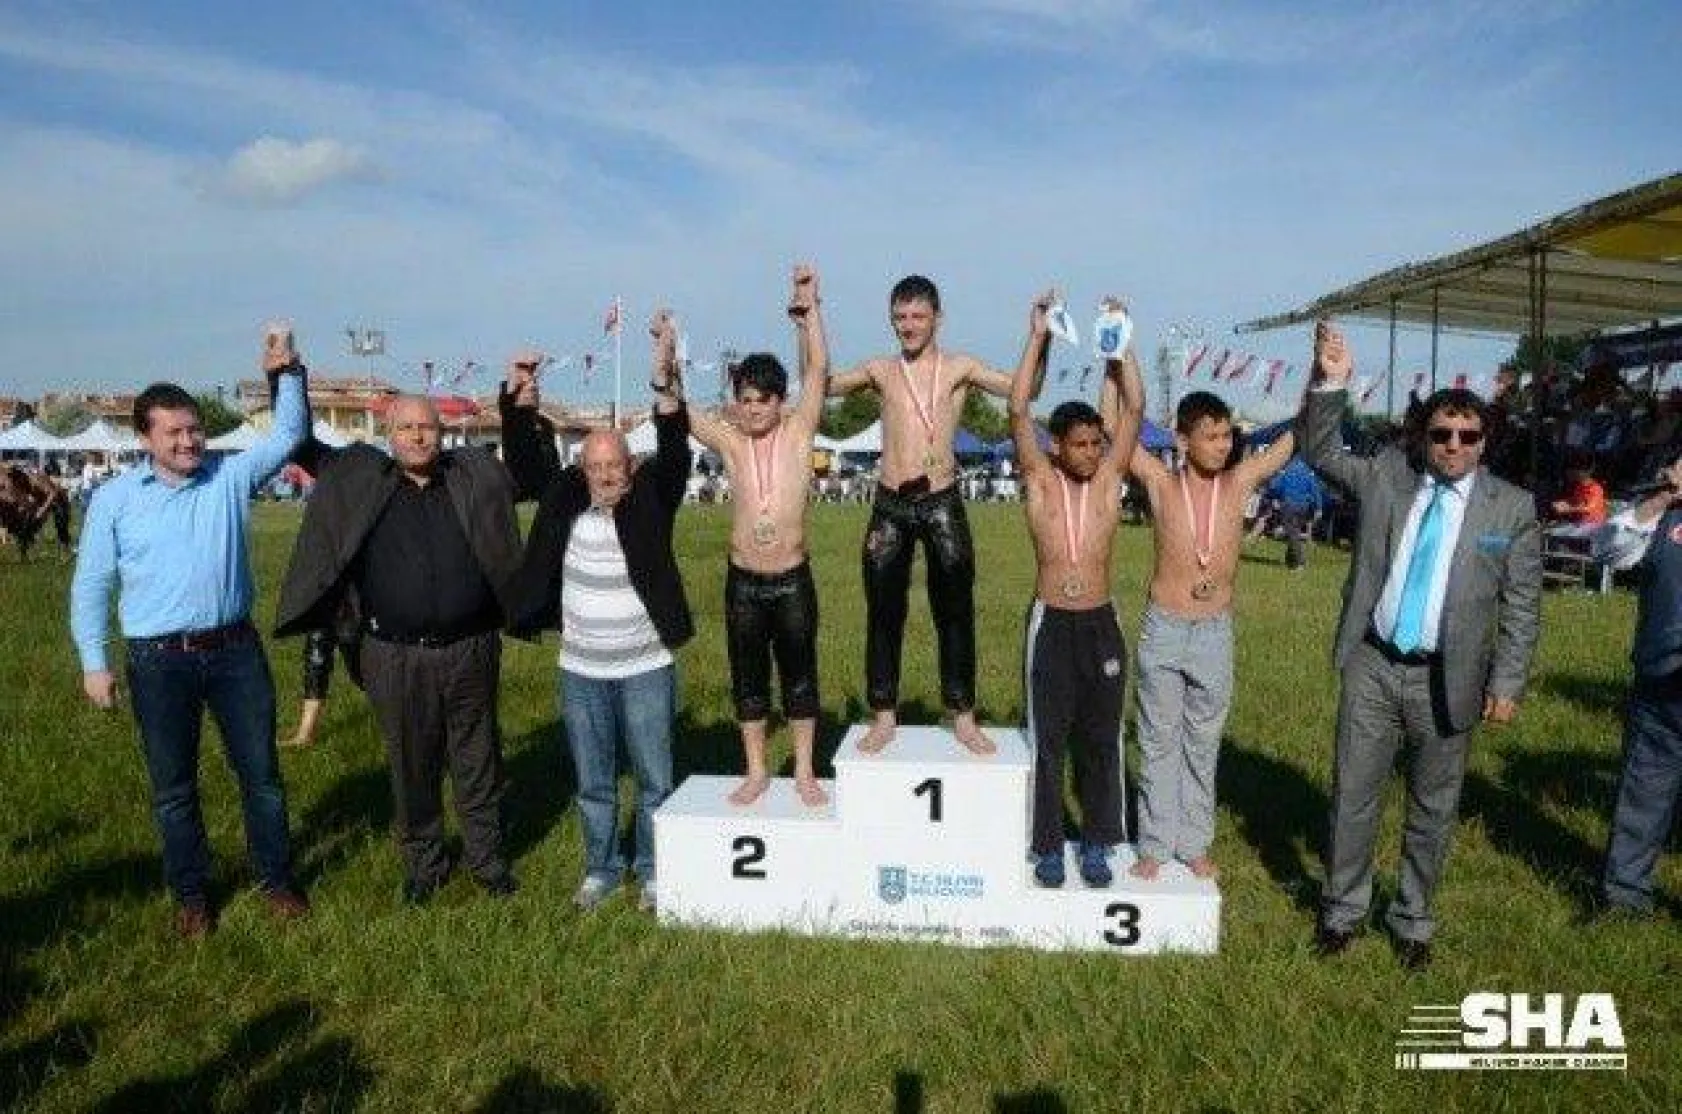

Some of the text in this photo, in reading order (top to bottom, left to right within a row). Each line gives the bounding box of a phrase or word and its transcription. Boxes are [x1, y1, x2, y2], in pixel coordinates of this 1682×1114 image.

[915, 778, 941, 820] 1
[733, 836, 765, 878] 2
[1104, 904, 1140, 946] 3
